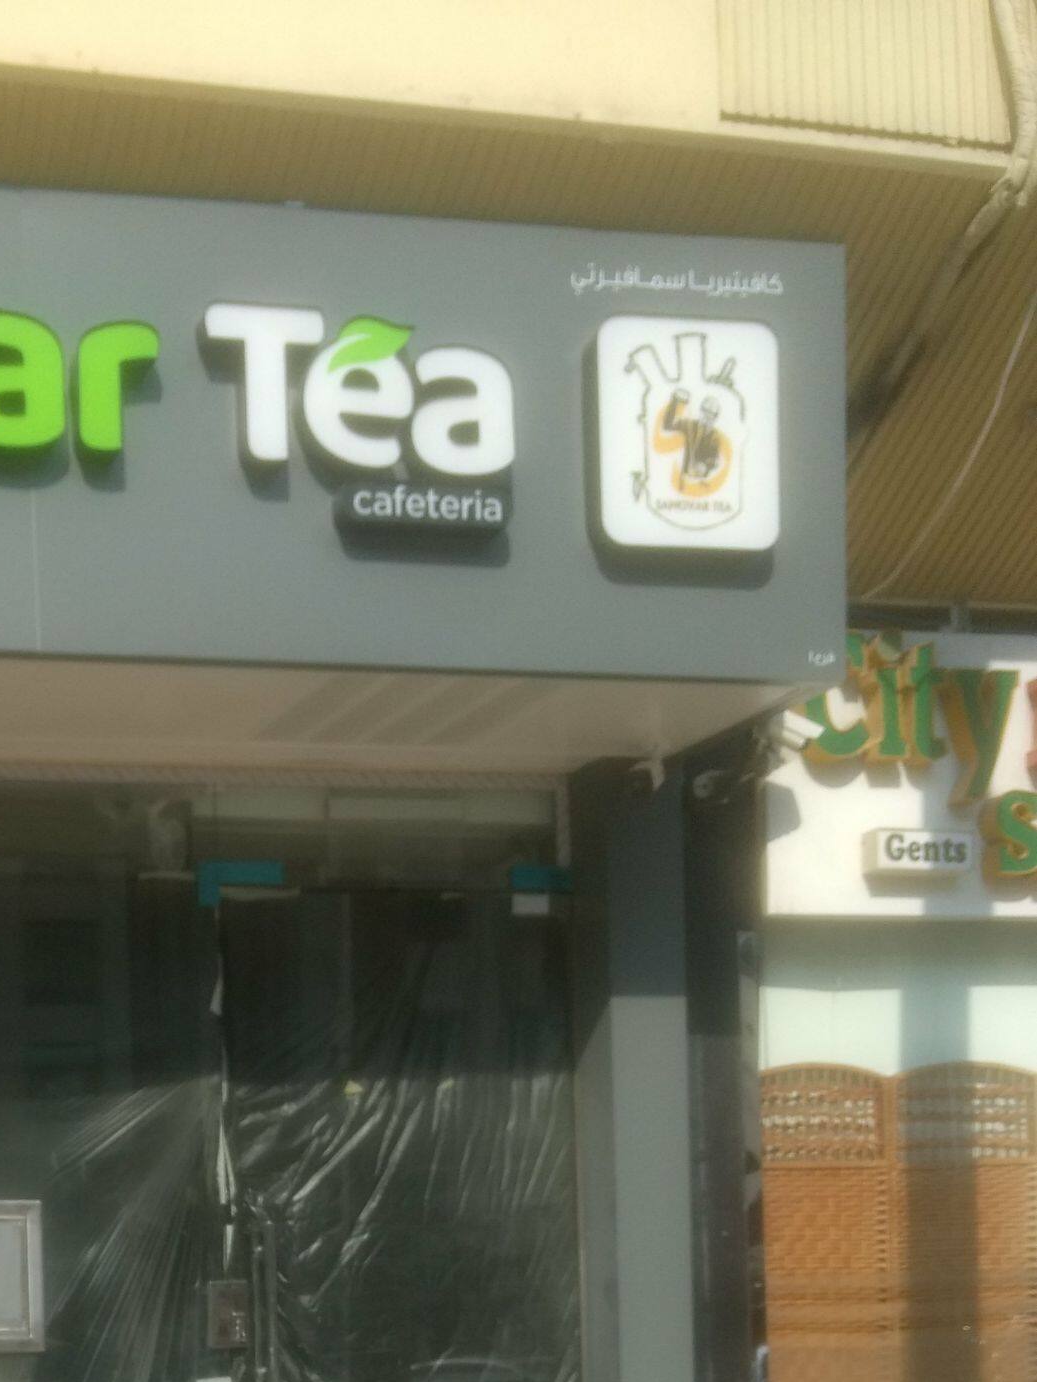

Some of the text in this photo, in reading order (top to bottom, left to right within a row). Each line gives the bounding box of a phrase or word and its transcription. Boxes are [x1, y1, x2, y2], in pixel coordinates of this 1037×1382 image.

[204, 302, 514, 476] Tea
[352, 484, 503, 523] cafeteria
[884, 832, 967, 863] Gents
